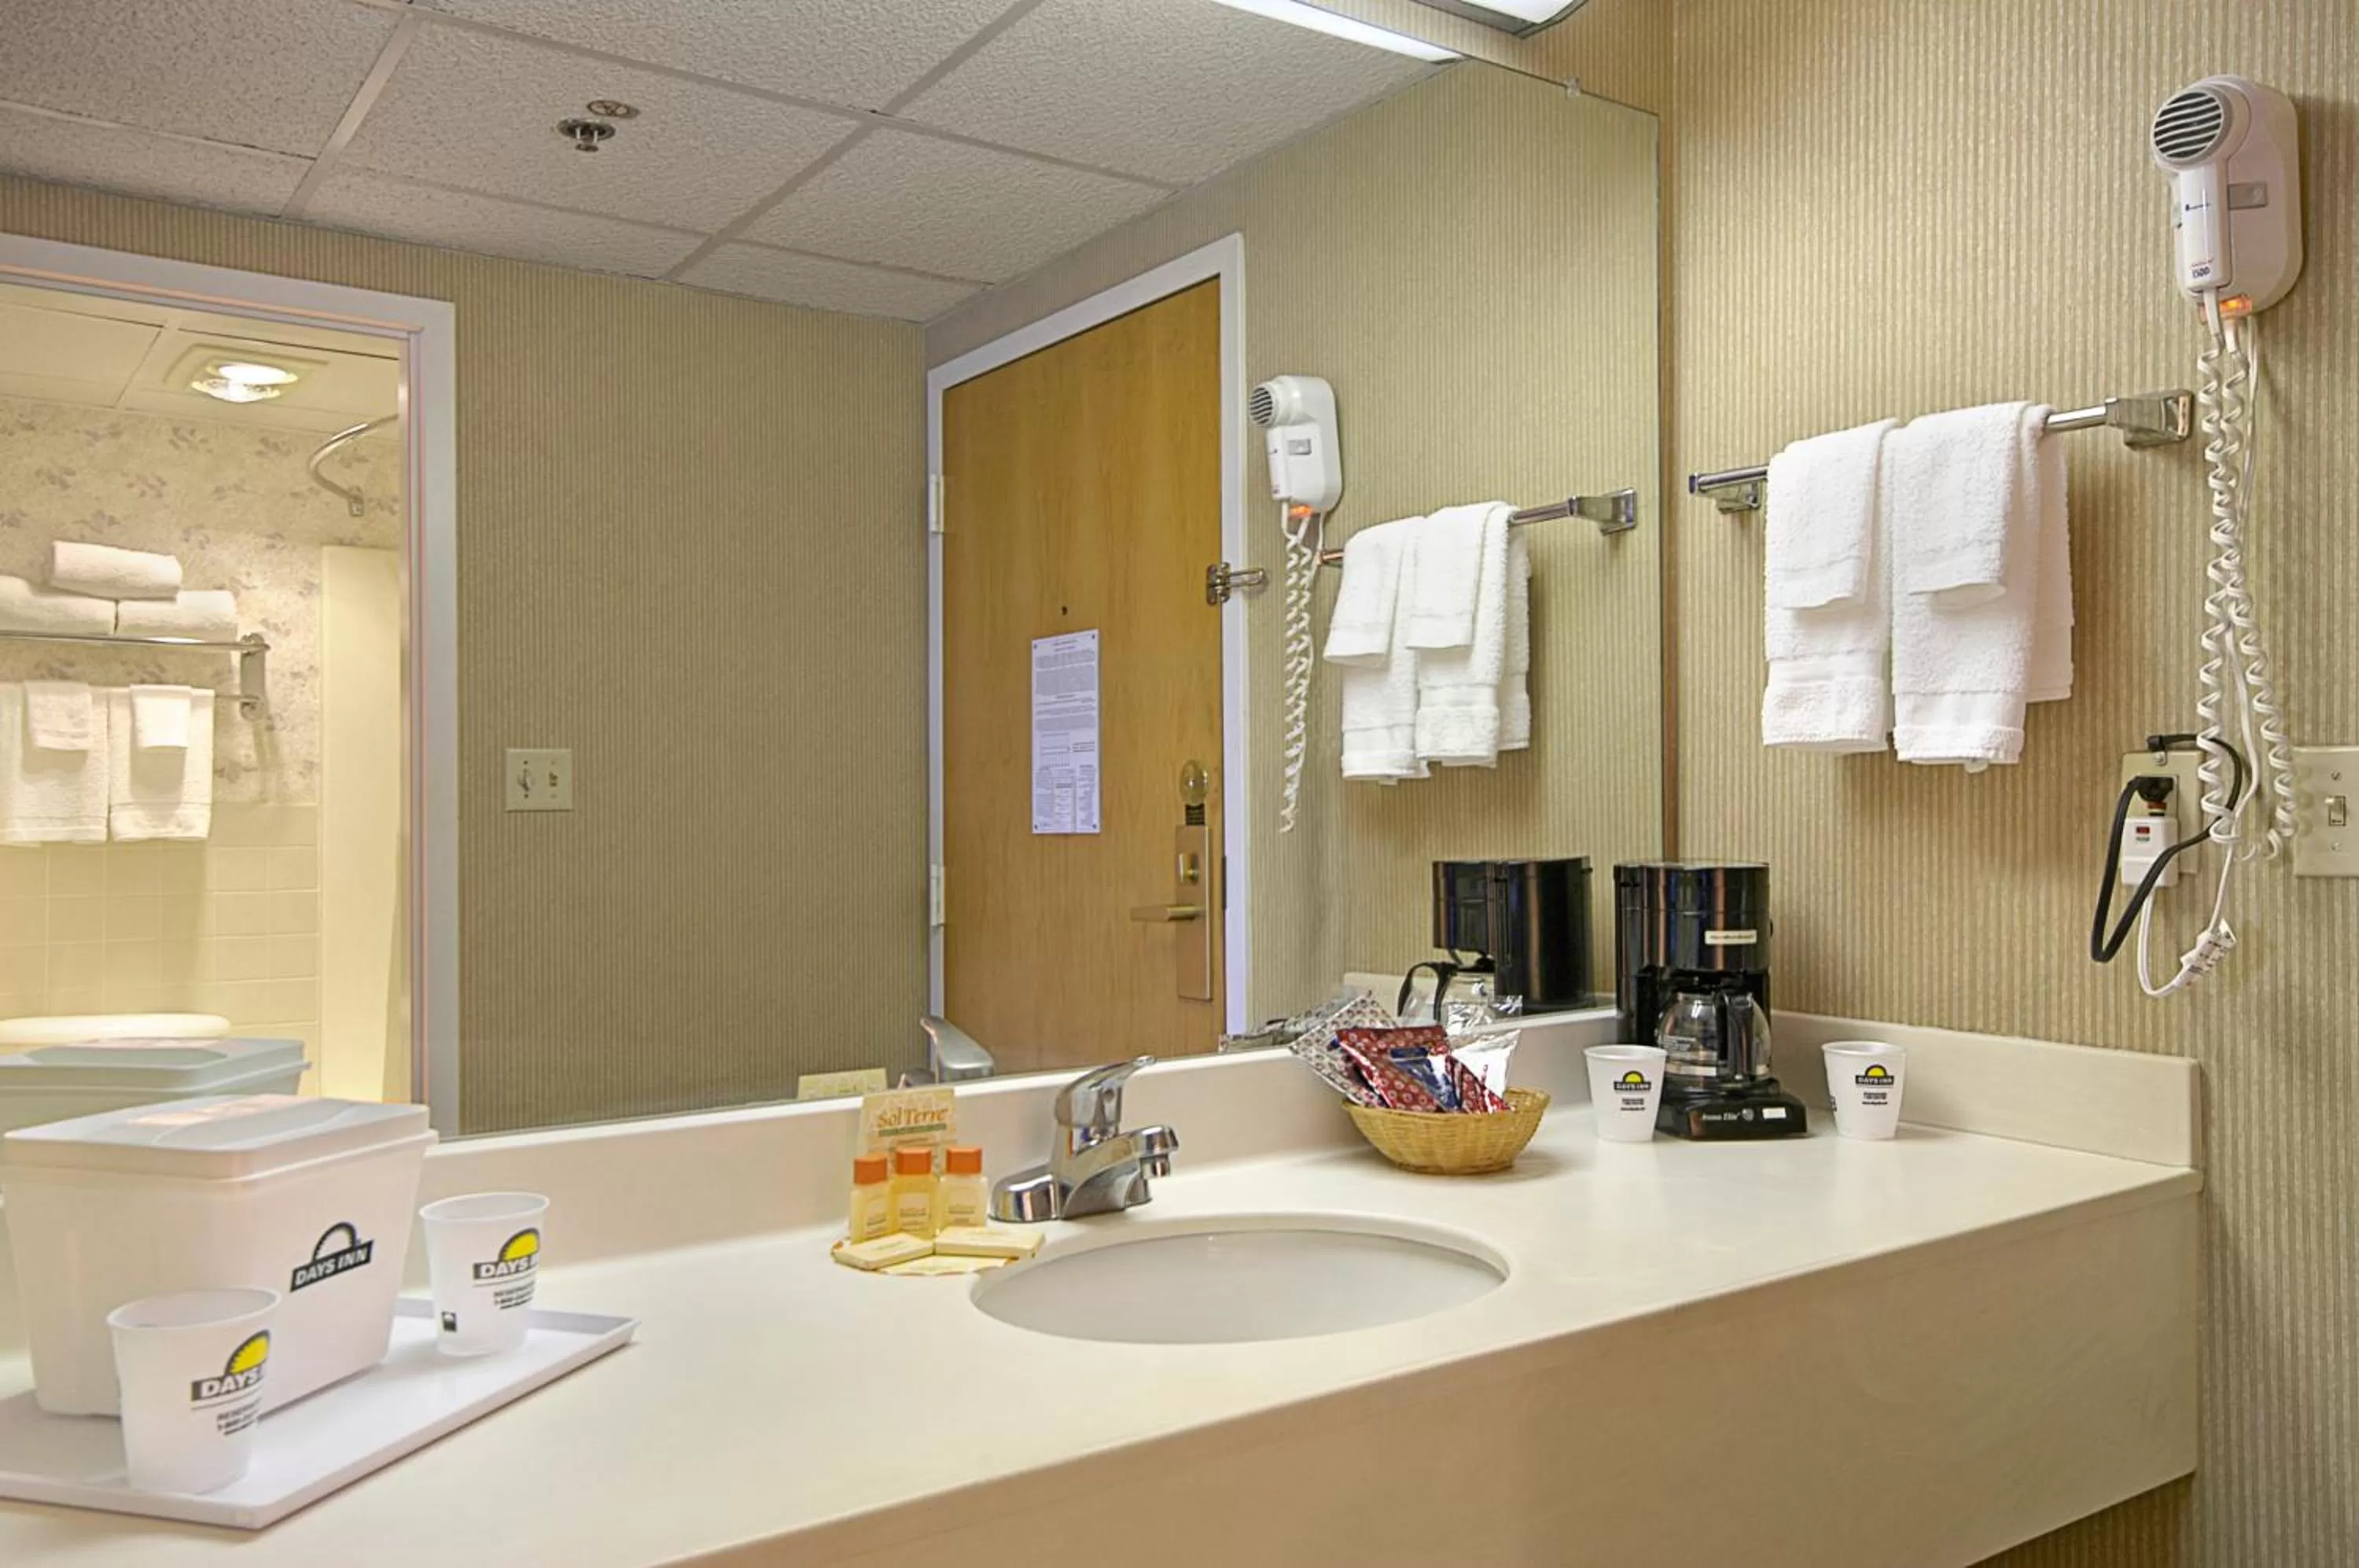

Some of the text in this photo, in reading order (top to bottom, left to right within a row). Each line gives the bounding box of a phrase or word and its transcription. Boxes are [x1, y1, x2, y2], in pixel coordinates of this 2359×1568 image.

[295, 1247, 366, 1286] DAYS INN
[480, 1257, 529, 1278] DAYS
[201, 1369, 259, 1397] DAYS
